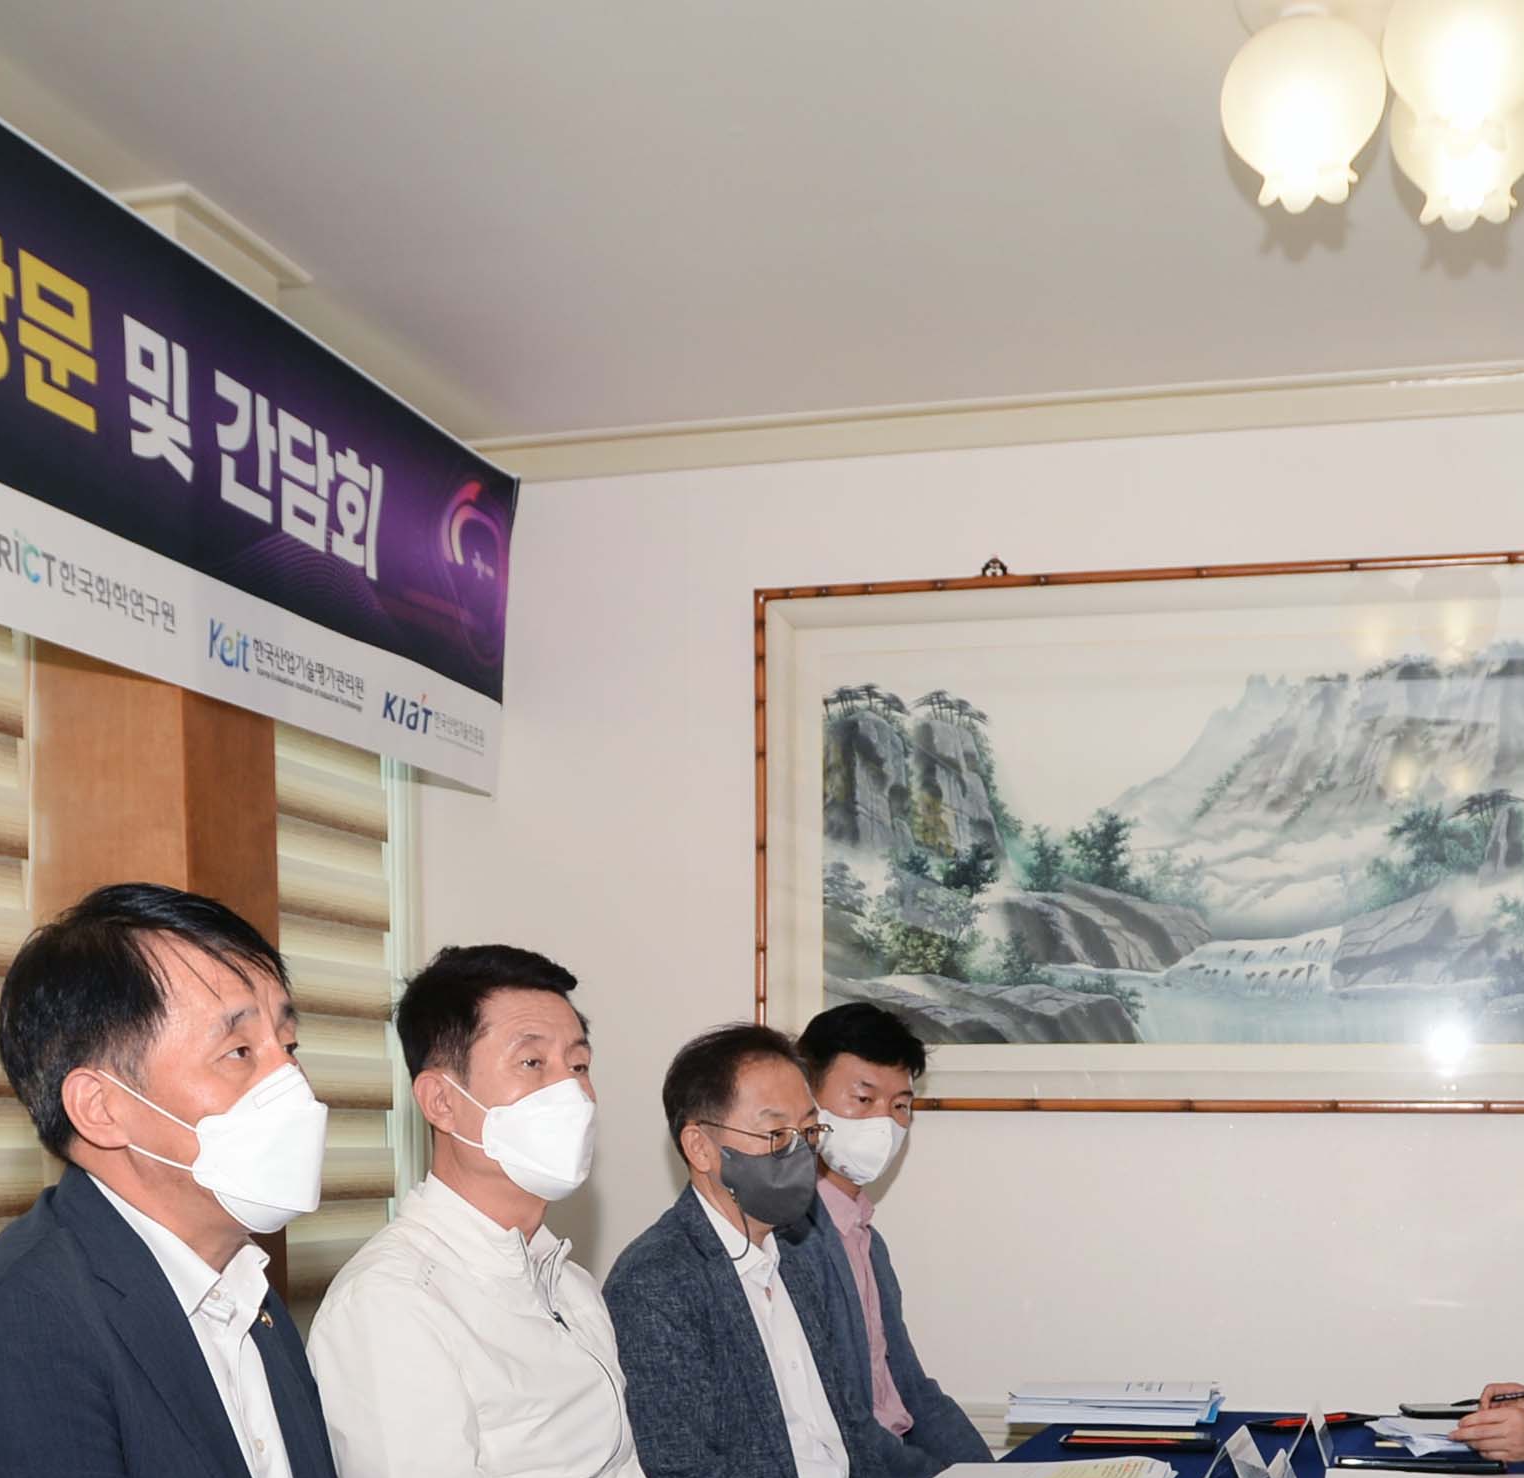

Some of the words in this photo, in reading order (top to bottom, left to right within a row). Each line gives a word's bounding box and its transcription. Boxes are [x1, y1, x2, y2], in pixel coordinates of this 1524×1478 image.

[123, 314, 193, 483] 및
[214, 369, 385, 580] 간담회
[60, 560, 176, 634] 한국화학연구원
[253, 639, 364, 700] 한국산업기술평가관리원
